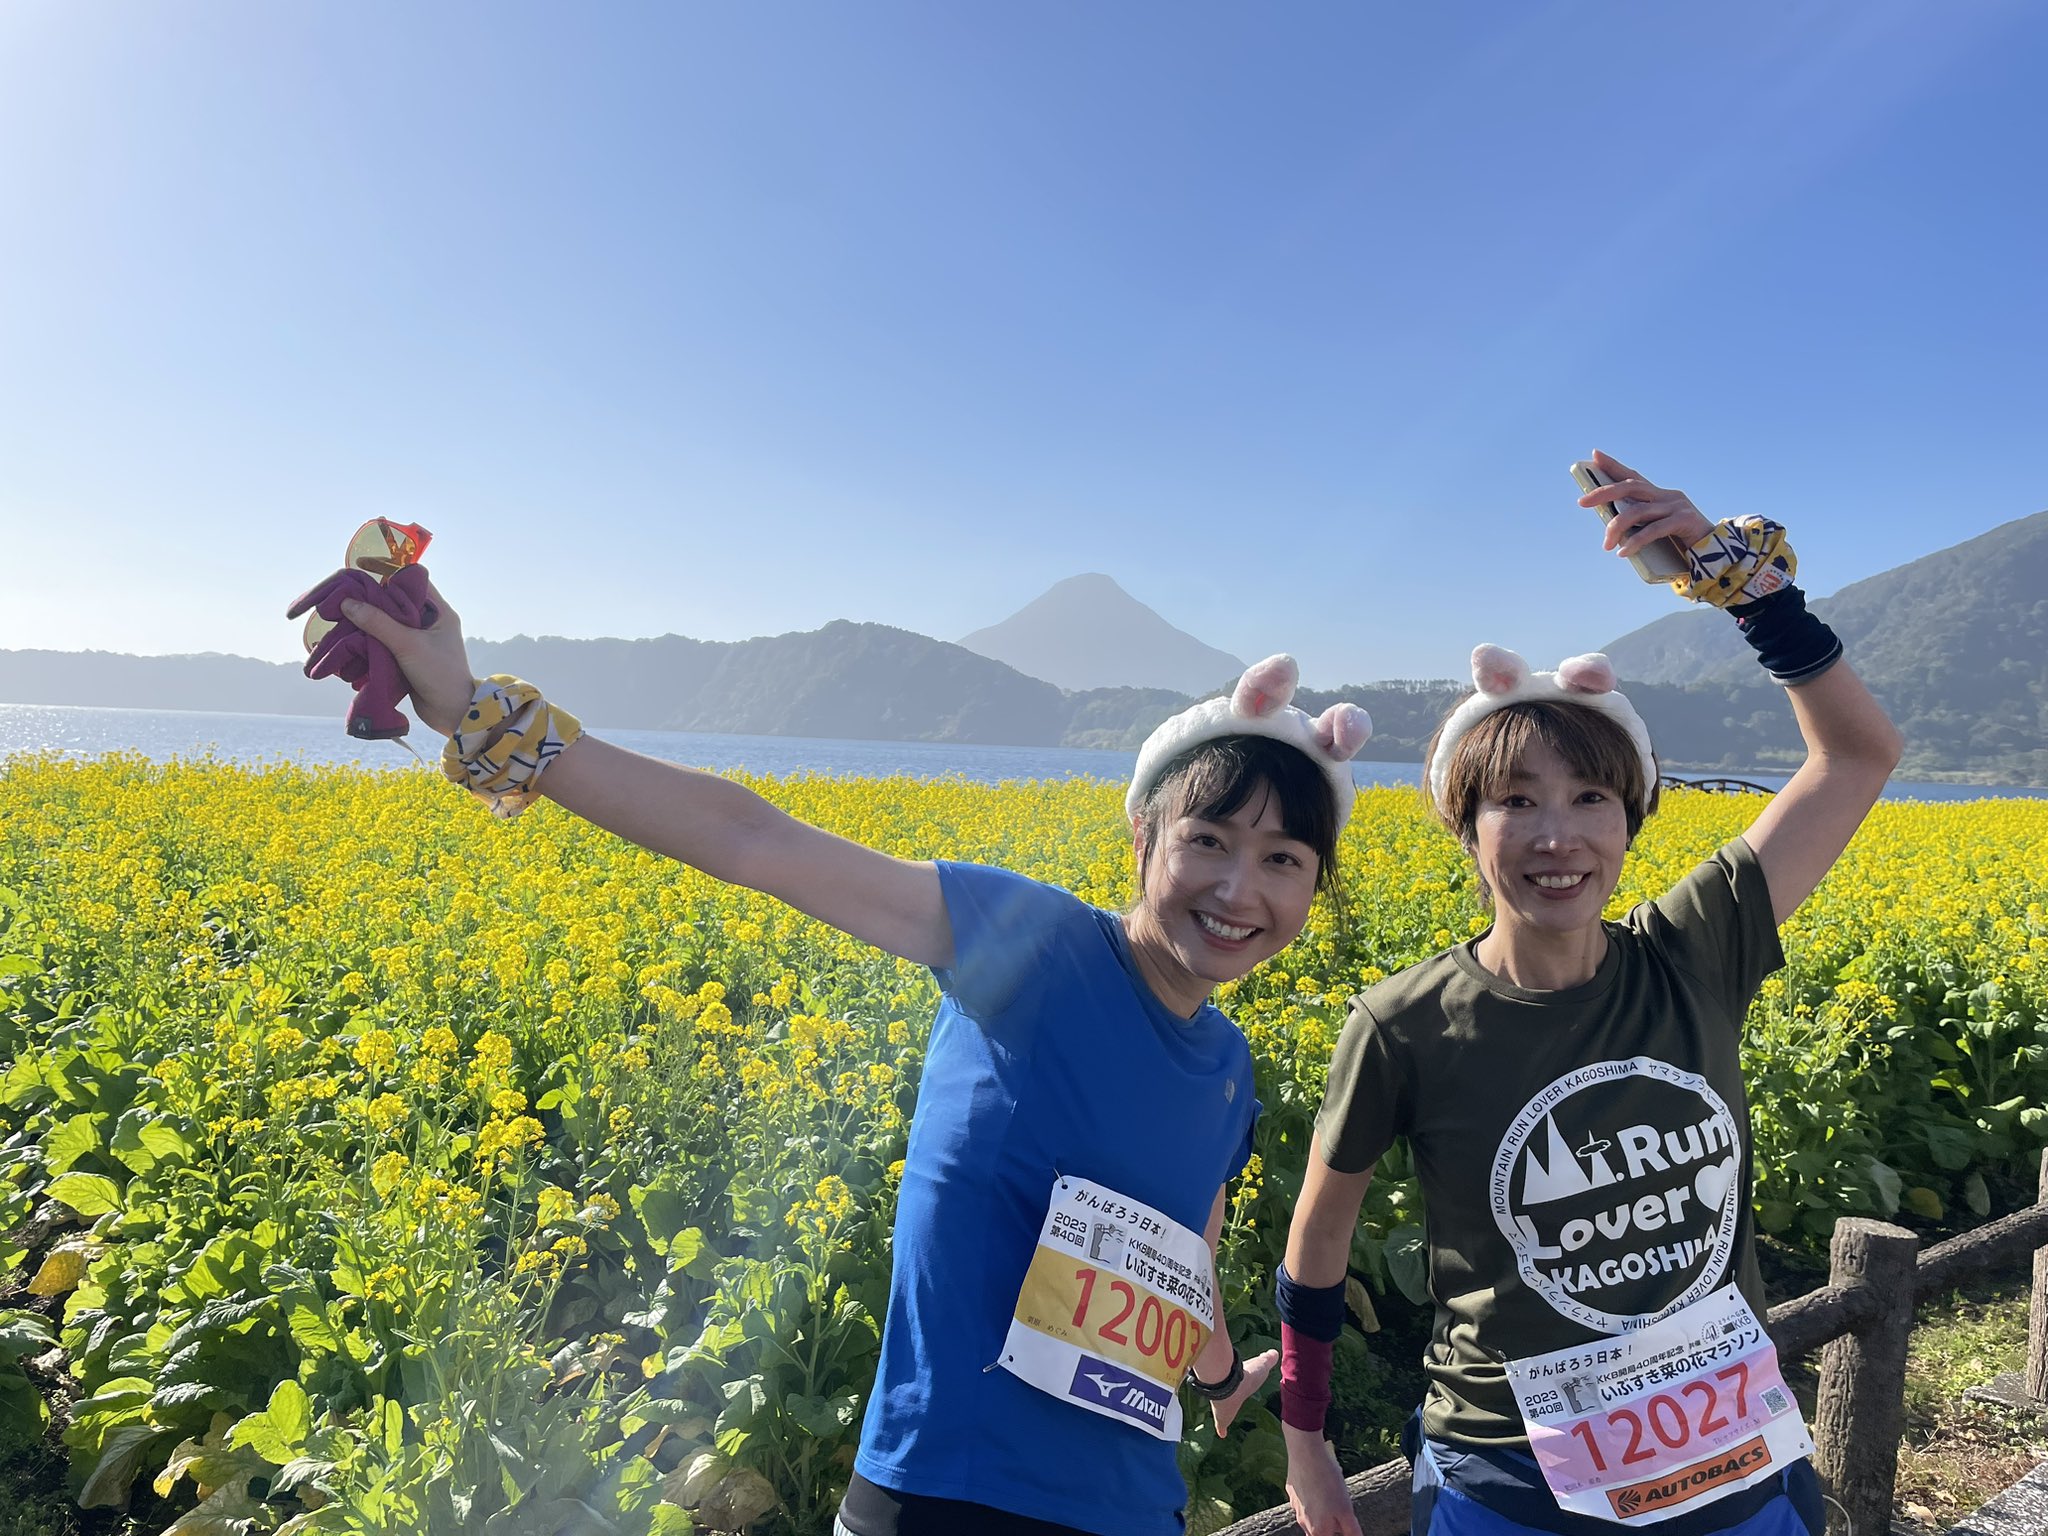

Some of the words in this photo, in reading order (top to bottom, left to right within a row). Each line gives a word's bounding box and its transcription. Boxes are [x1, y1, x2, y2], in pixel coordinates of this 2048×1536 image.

[1493, 1148, 1513, 1215] MOUNTAIN
[1507, 1118, 1530, 1147] RUN
[1526, 1085, 1564, 1119] LOVER
[1564, 1061, 1639, 1090] KAGOSHIMA
[1050, 1224, 1085, 1247] 第40回
[1054, 1211, 1088, 1234] 2023
[1514, 1185, 1691, 1260] Lover
[1712, 1240, 1729, 1268] RUN
[1686, 1267, 1718, 1303] LOVER
[1733, 1315, 1752, 1329] KKB
[1595, 1345, 1684, 1384] KKB開局40周年記念
[1601, 1328, 1760, 1401] いぶすき菜の花マラソン
[1524, 1390, 1558, 1407] 2023
[1528, 1401, 1564, 1419] 第40回
[1570, 1361, 1749, 1472] 12027
[1644, 1444, 1765, 1503] AUTOBACS
